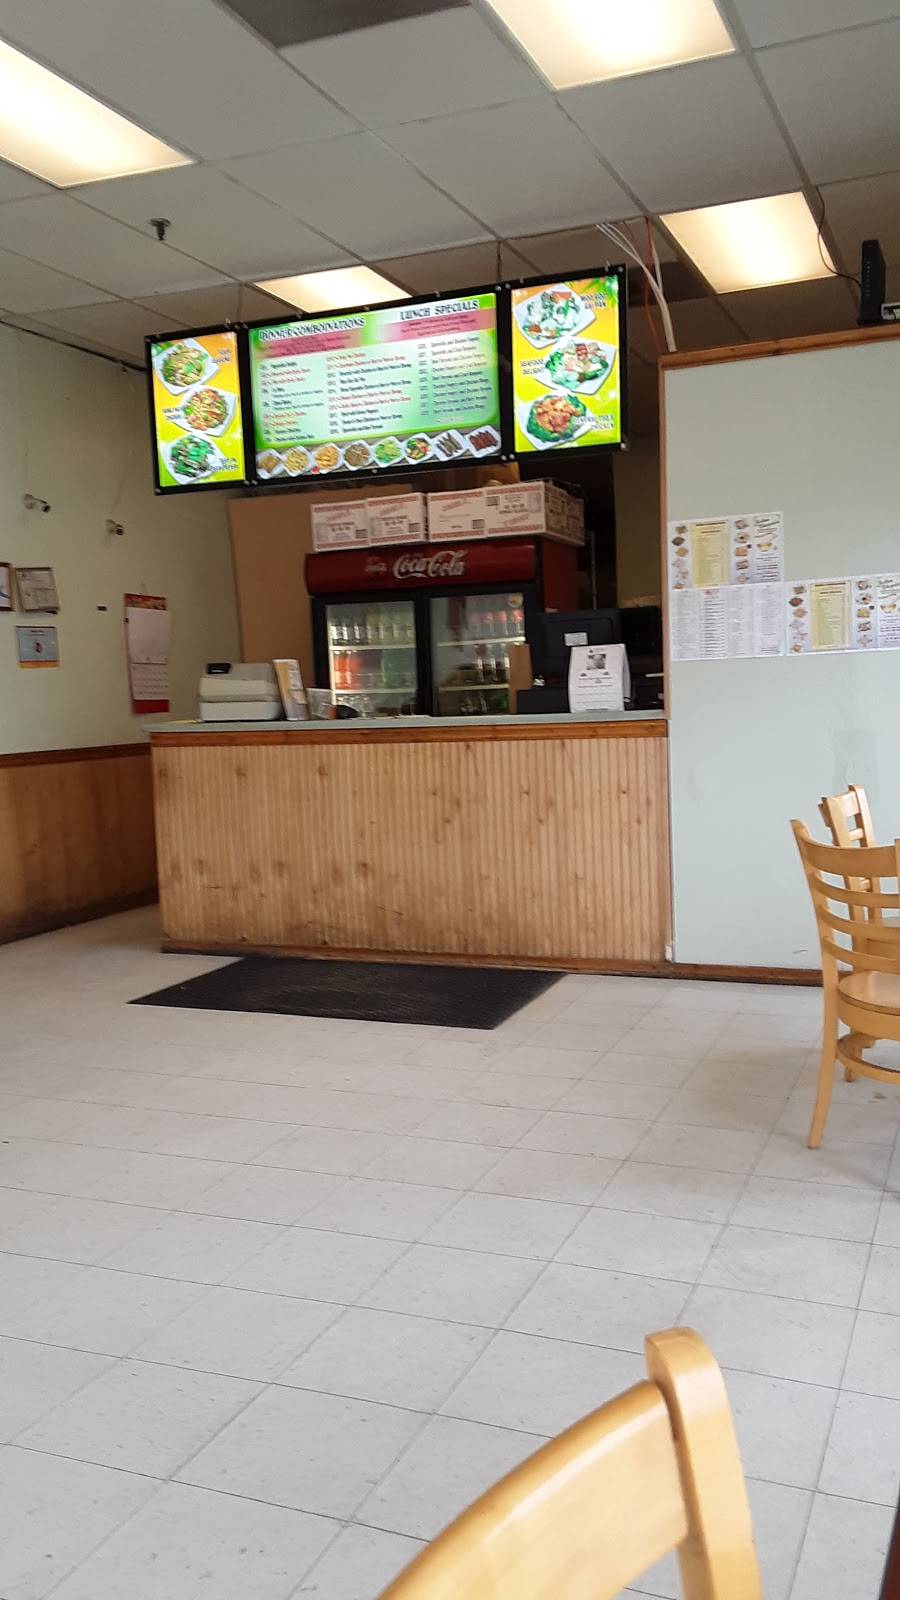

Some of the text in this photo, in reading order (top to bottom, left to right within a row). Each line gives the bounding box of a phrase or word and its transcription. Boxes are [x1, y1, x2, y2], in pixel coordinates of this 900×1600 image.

[400, 300, 480, 320] LUNCH SPECIALS
[392, 550, 467, 579] Coca-Cola
